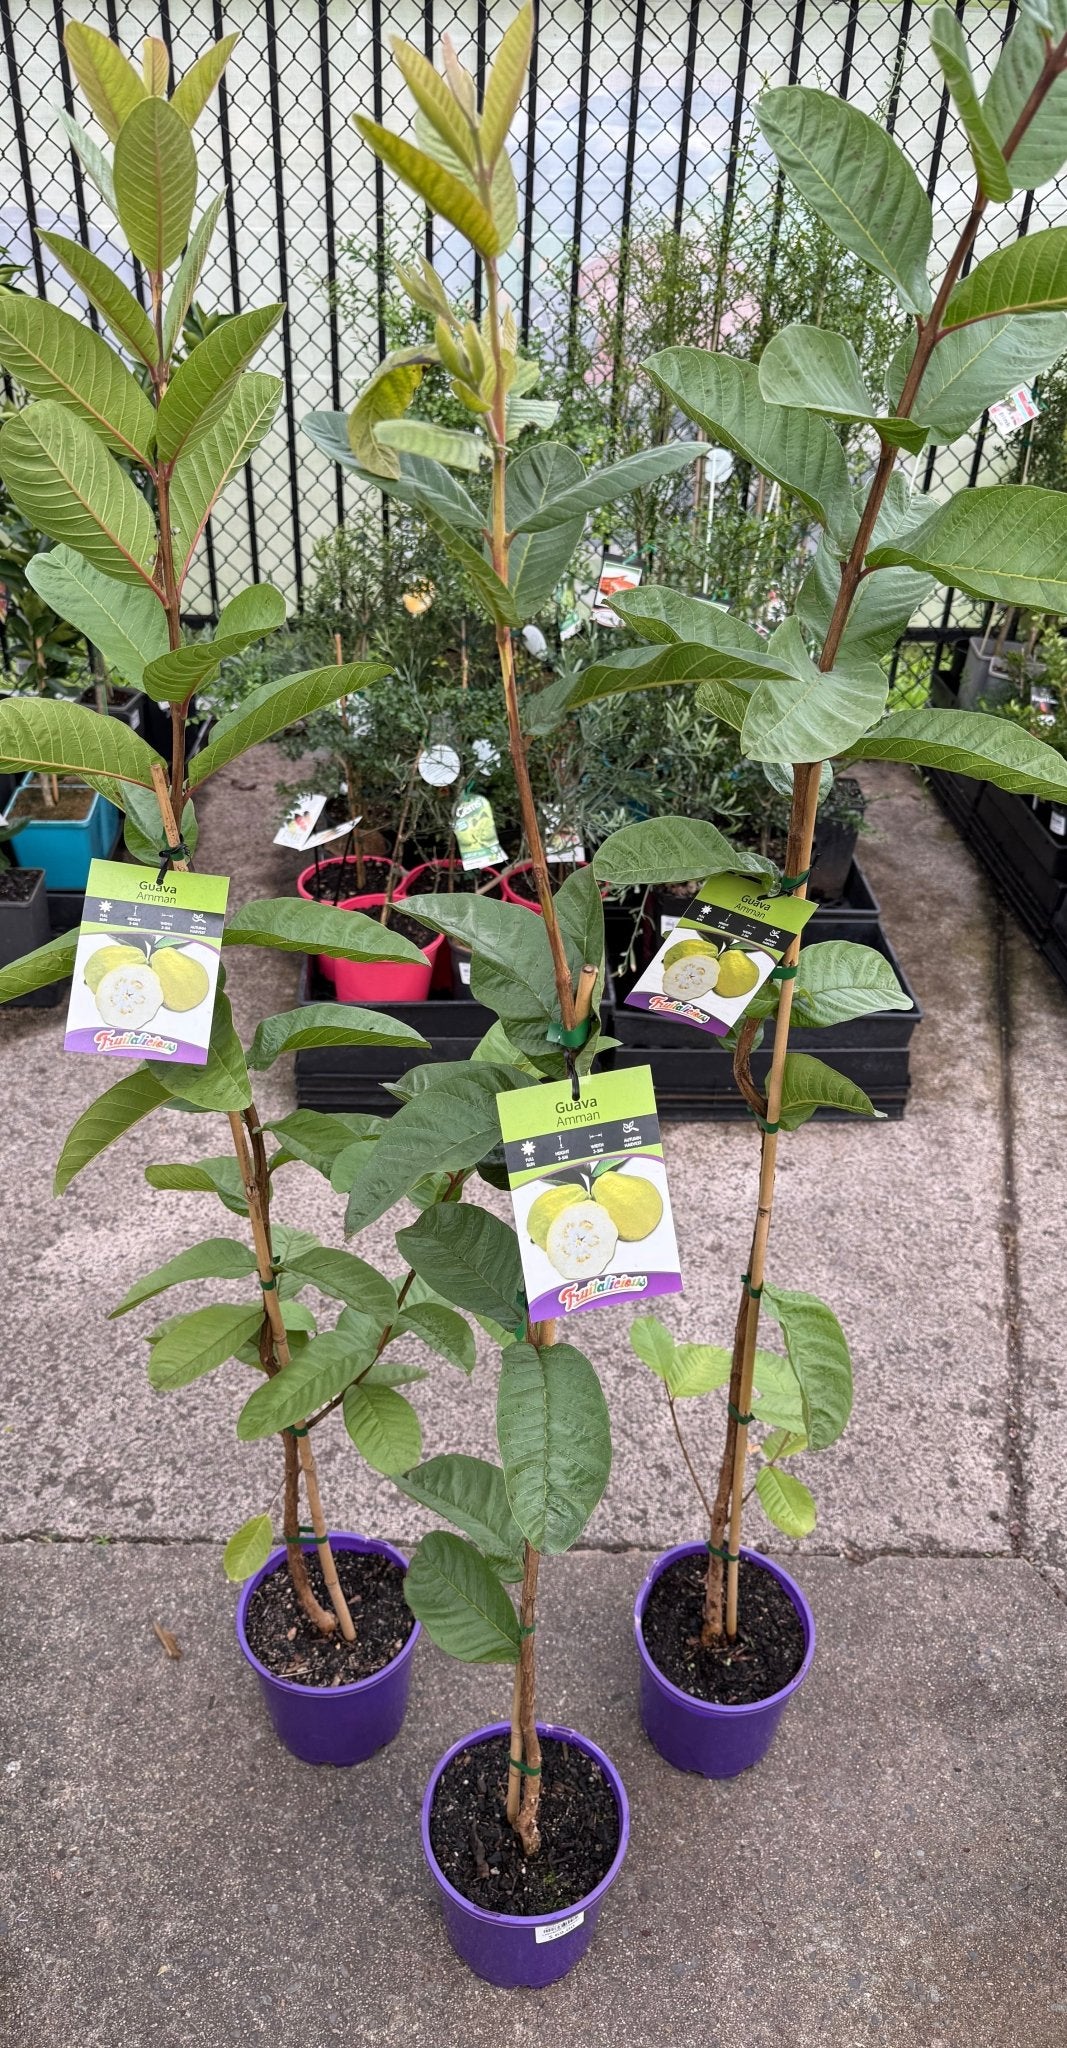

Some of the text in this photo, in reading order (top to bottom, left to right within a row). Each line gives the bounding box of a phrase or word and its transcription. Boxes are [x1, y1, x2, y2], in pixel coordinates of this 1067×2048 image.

[139, 880, 177, 895] Guava
[136, 891, 177, 905] Amman
[741, 894, 771, 912] Guava
[733, 903, 766, 920] Amman
[649, 996, 710, 1023] Fruitalicious
[94, 1031, 177, 1053] Fruitalicious
[555, 1097, 598, 1114] Guava
[556, 1110, 600, 1128] Amman
[559, 1275, 647, 1311] Fruitalicious
